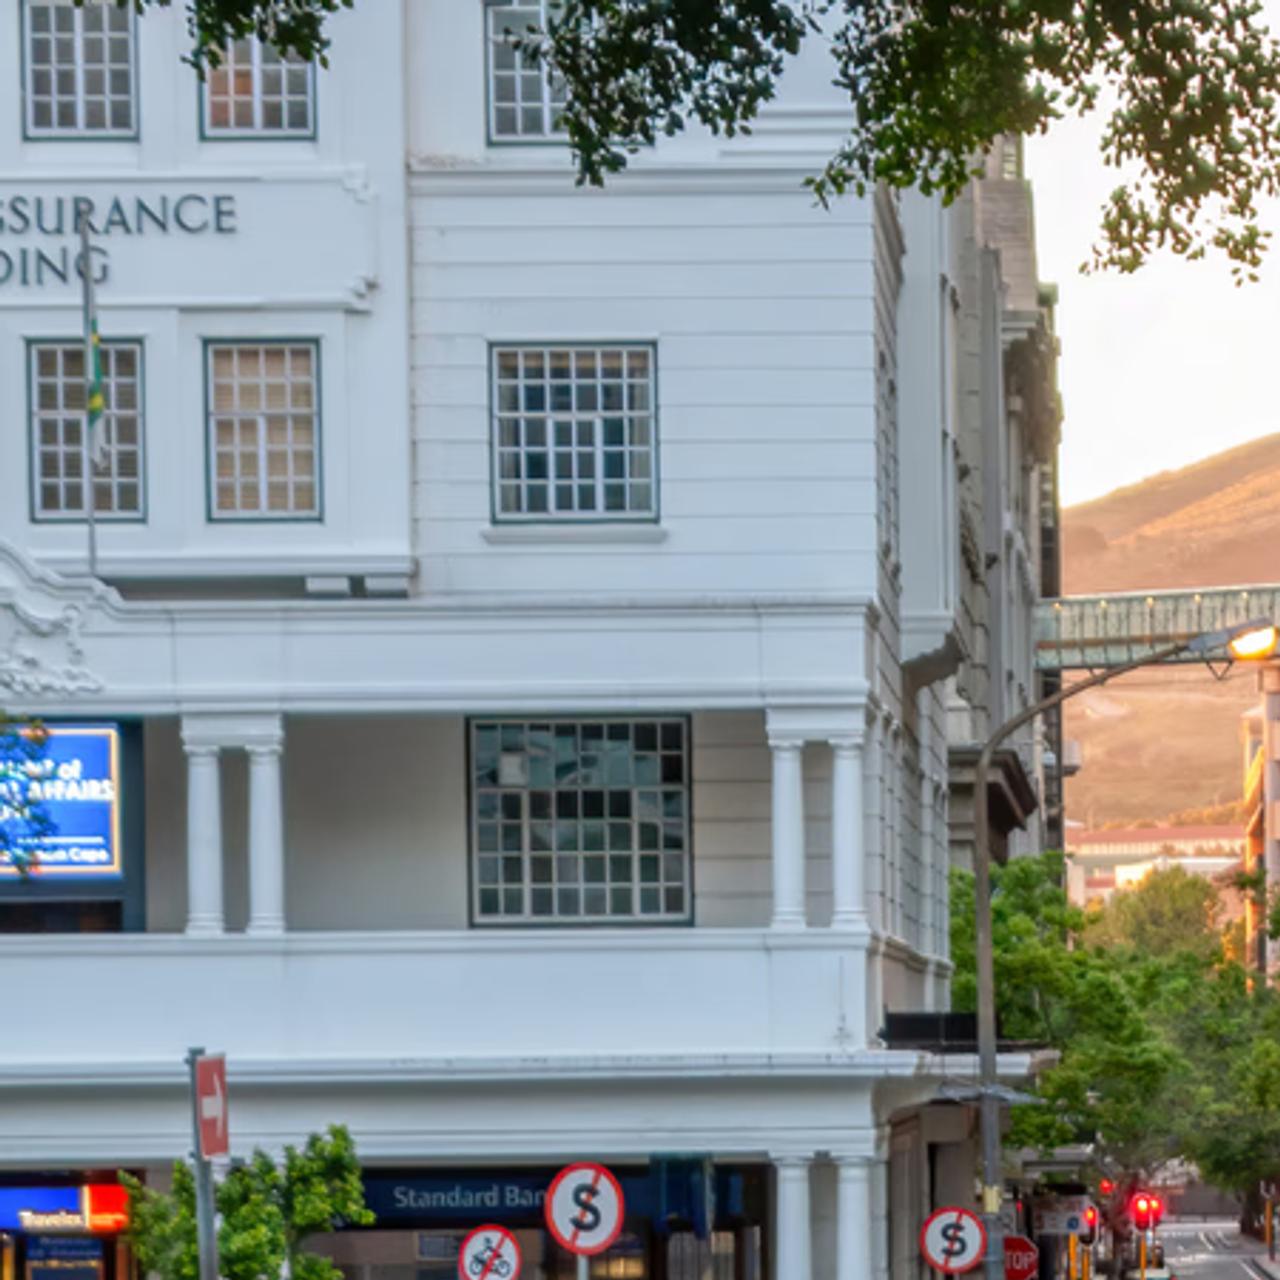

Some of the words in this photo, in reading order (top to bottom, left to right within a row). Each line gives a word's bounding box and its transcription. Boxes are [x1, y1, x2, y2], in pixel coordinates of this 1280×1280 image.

[0, 194, 237, 235] SURANCE
[393, 1184, 499, 1208] Standard
[504, 1185, 549, 1207] Ban
[1004, 1250, 1036, 1270] TOP
